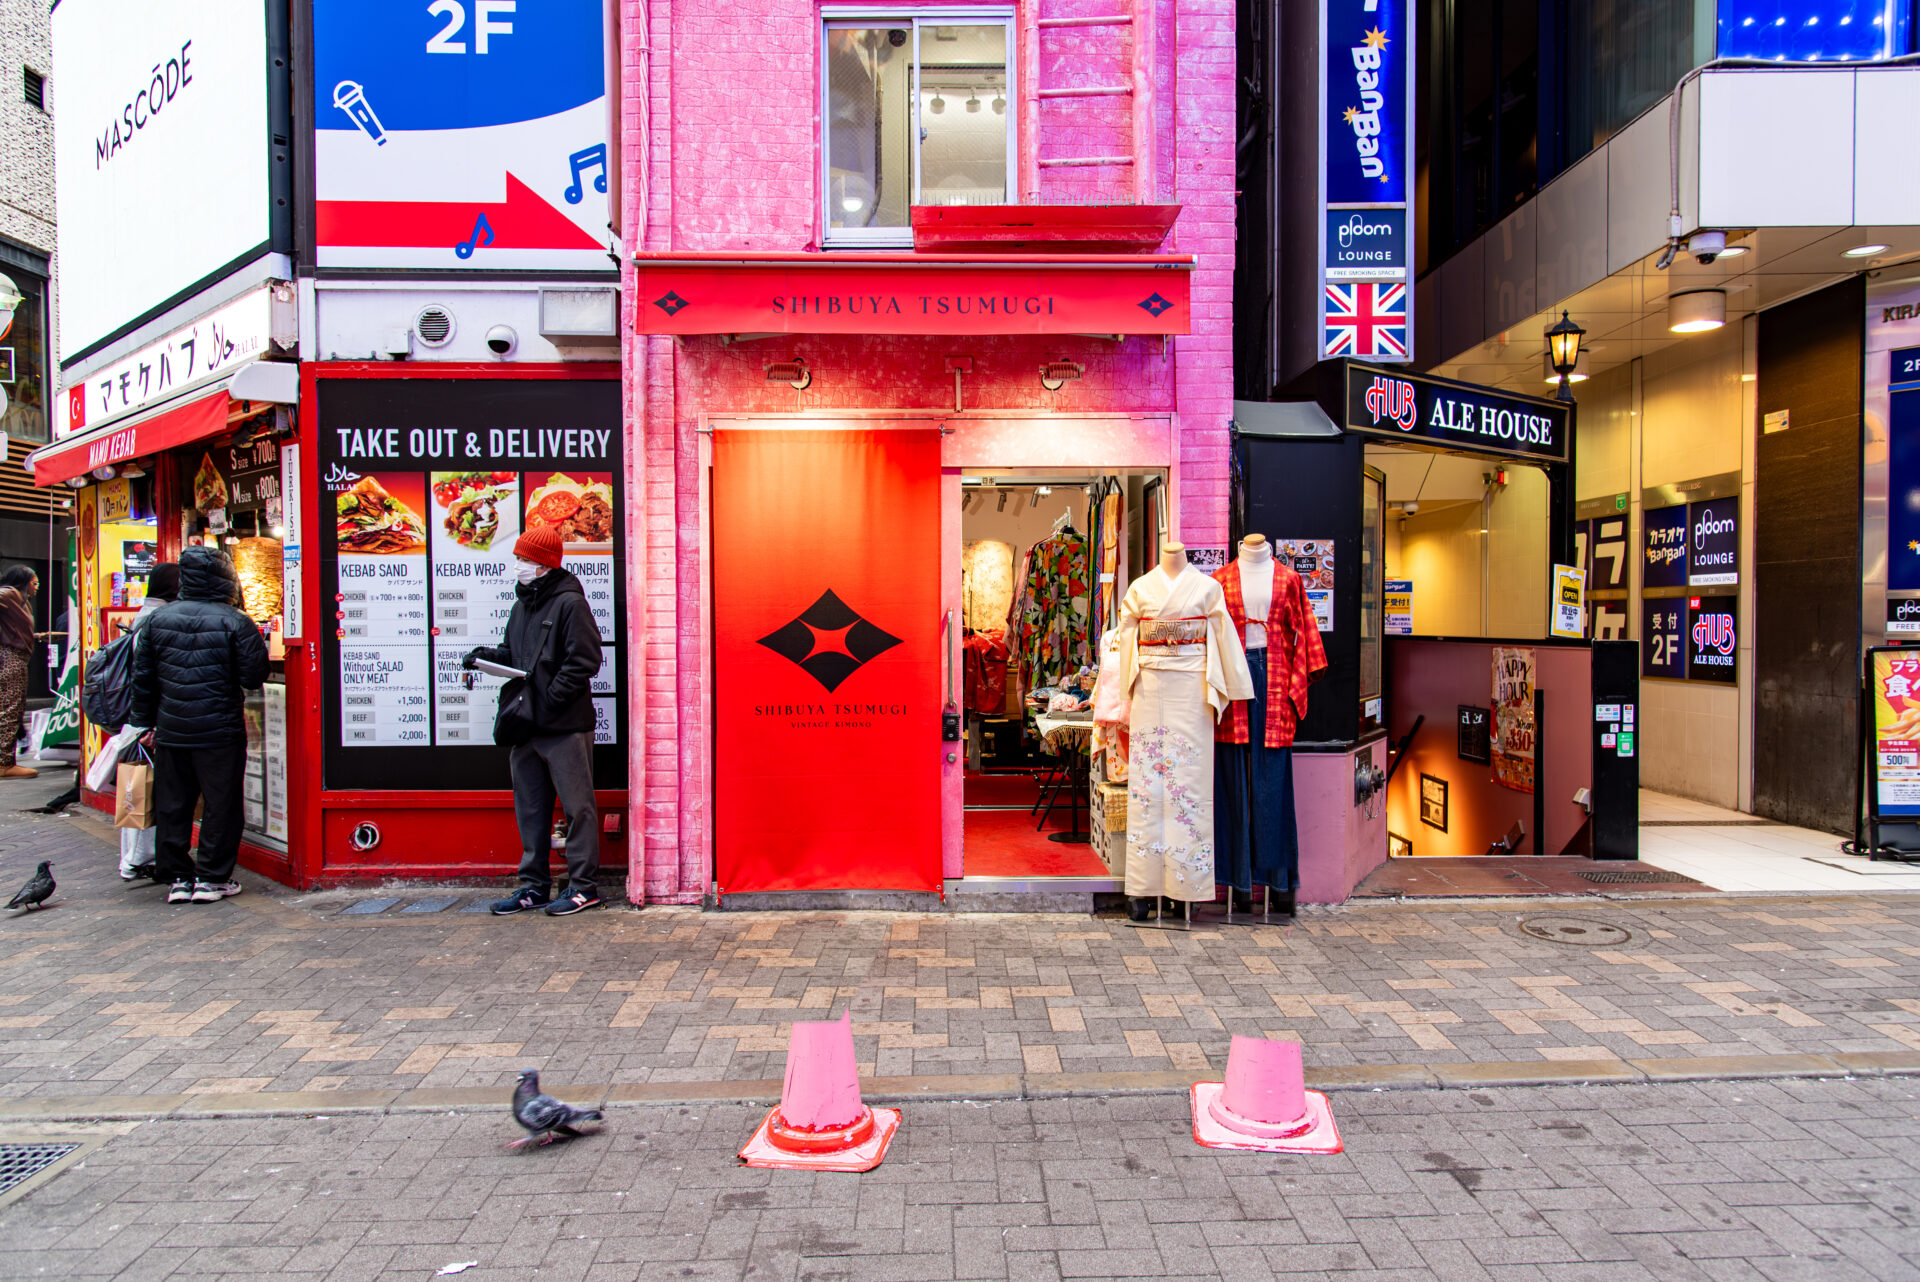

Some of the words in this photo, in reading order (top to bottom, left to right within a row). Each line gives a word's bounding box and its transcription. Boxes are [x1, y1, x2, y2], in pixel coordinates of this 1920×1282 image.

[426, 0, 516, 54] 2F
[1351, 40, 1384, 178] BanBan
[1338, 214, 1392, 248] ploom
[1338, 251, 1392, 261] LOUNGE
[772, 296, 902, 314] SHIBUYA
[919, 296, 1054, 314] TSUMUGI
[100, 326, 198, 413] マモケバブ
[1365, 376, 1417, 432] HUB
[1429, 397, 1475, 433] ALE
[1480, 406, 1552, 445] HOUSE
[88, 437, 108, 470] MAMO
[109, 428, 136, 462] KEBAB
[336, 428, 400, 458] TAKE
[409, 428, 458, 458] OUT
[465, 431, 482, 458] &
[490, 429, 611, 458] DELIVERY
[287, 448, 295, 542] TURKISH
[1650, 526, 1685, 545] カラオケ
[1695, 508, 1734, 551] ploom
[1650, 545, 1685, 564] BanBan
[1694, 552, 1734, 566] LOUNGE
[341, 563, 376, 577] KEBAB
[379, 563, 408, 577] SAND
[436, 563, 470, 577] KEBAB
[474, 563, 506, 577] WRAP
[566, 562, 609, 576] DONBURI
[344, 593, 366, 601] CHICKEN
[438, 592, 464, 600] CHICKEN
[496, 591, 514, 601] ¥900
[348, 610, 363, 618] BEEF
[444, 609, 459, 617] BEEF
[1652, 612, 1678, 630] 受付
[350, 627, 361, 635] MIX
[446, 627, 457, 635] MIX
[1692, 613, 1736, 656] HUB
[343, 651, 363, 660] KEBAB
[363, 651, 381, 660] SAND
[437, 651, 458, 659] KEBAB
[1651, 634, 1679, 666] 2F
[343, 661, 374, 672] Without
[376, 661, 404, 672] SALAD
[1693, 655, 1707, 664] ALE
[1708, 655, 1733, 666] HOUSE
[1497, 659, 1532, 680] HAPPY
[343, 673, 365, 683] ONLY
[367, 673, 390, 683] MEAT
[438, 672, 459, 683] ONLY
[1499, 681, 1530, 701] HOUR
[347, 697, 373, 705] CHICKEN
[398, 696, 423, 706] ¥1,500
[440, 696, 466, 704] CHICKEN
[446, 713, 461, 721] BEEF
[754, 704, 825, 716] SHIBUYA
[834, 704, 907, 715] TSUMUGI
[352, 714, 368, 722] BEEF
[398, 713, 423, 723] ¥2,000
[791, 721, 829, 729] VINTAGE
[353, 731, 366, 739] MIX
[399, 730, 424, 741] ¥2,000
[447, 730, 460, 738] MIX
[571, 893, 588, 907] N
